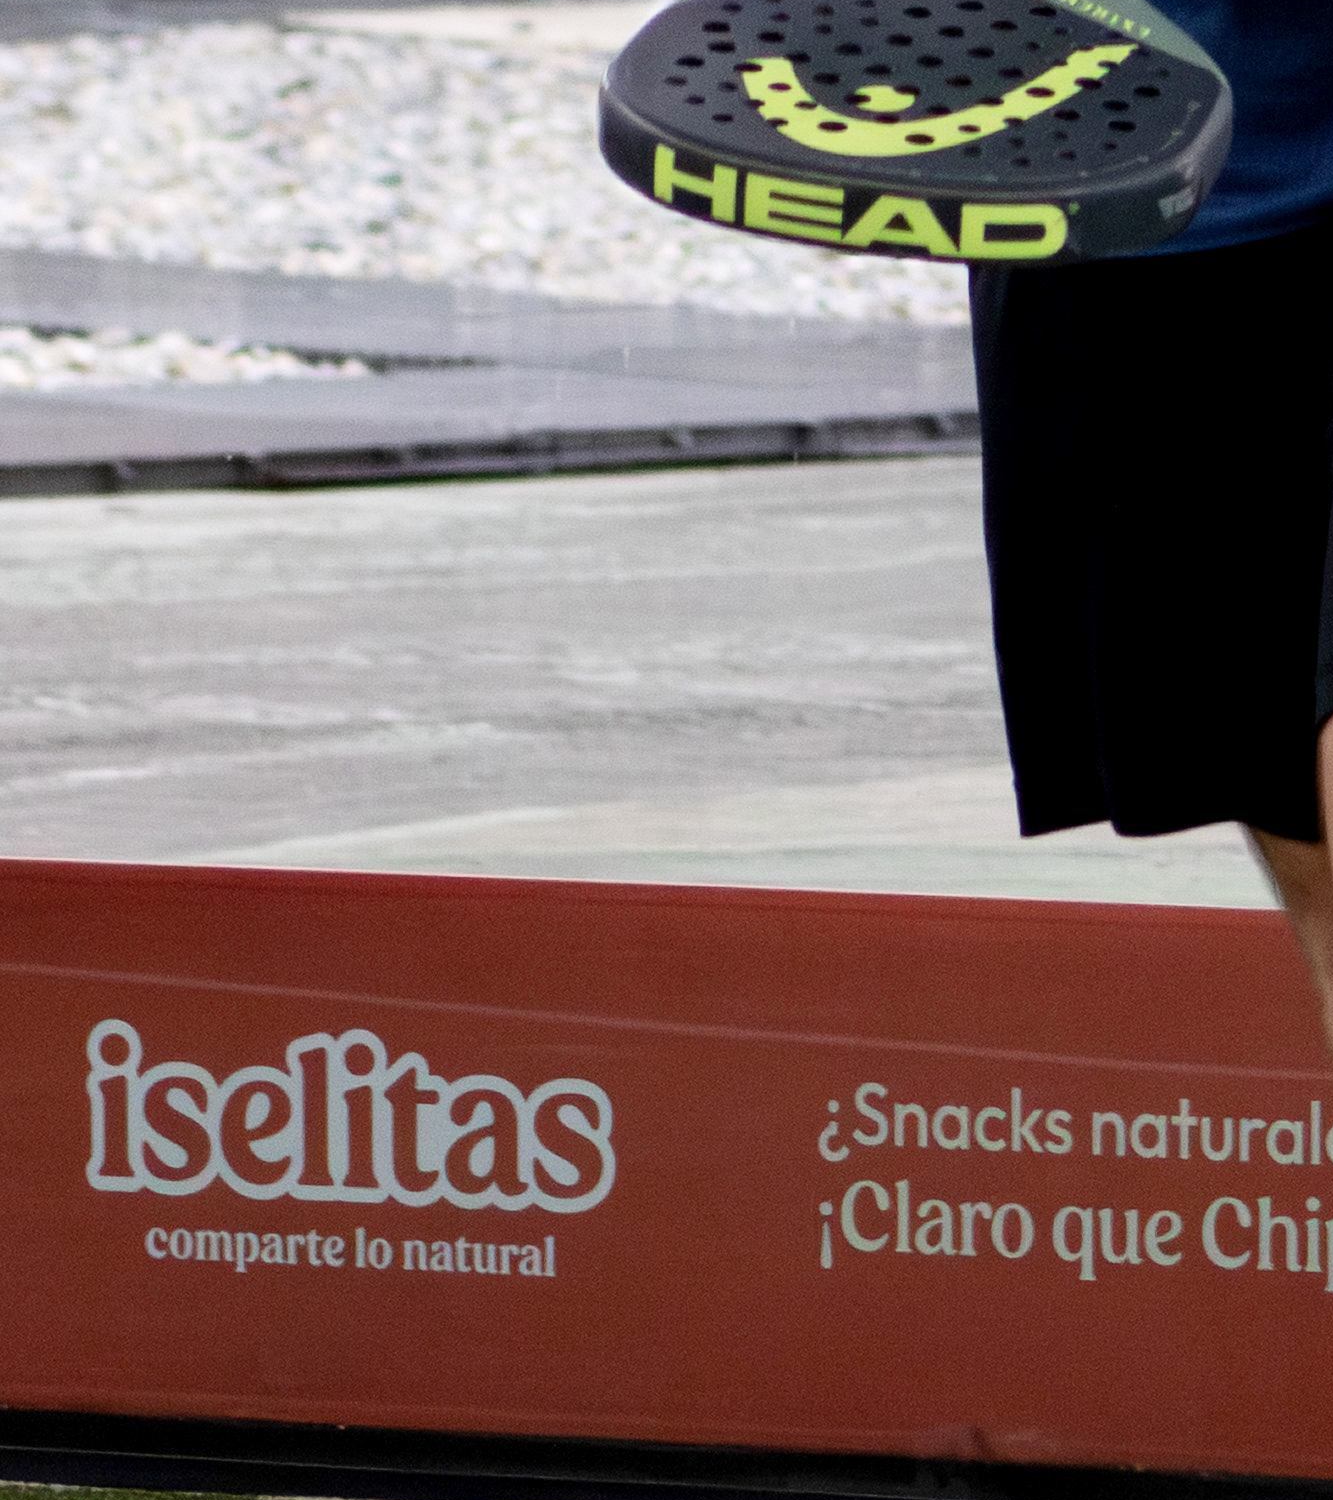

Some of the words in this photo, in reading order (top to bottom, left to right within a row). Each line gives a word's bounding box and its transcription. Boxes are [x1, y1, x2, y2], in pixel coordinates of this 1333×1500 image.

[653, 143, 1068, 259] HEAD
[86, 1019, 616, 1214] iselitas
[819, 1083, 1072, 1162] ¿Snacks
[145, 1228, 344, 1273] comparte
[356, 1228, 392, 1269] lo
[404, 1233, 555, 1277] natural
[820, 1180, 1034, 1268] ¡Claro
[1053, 1206, 1182, 1282] que
